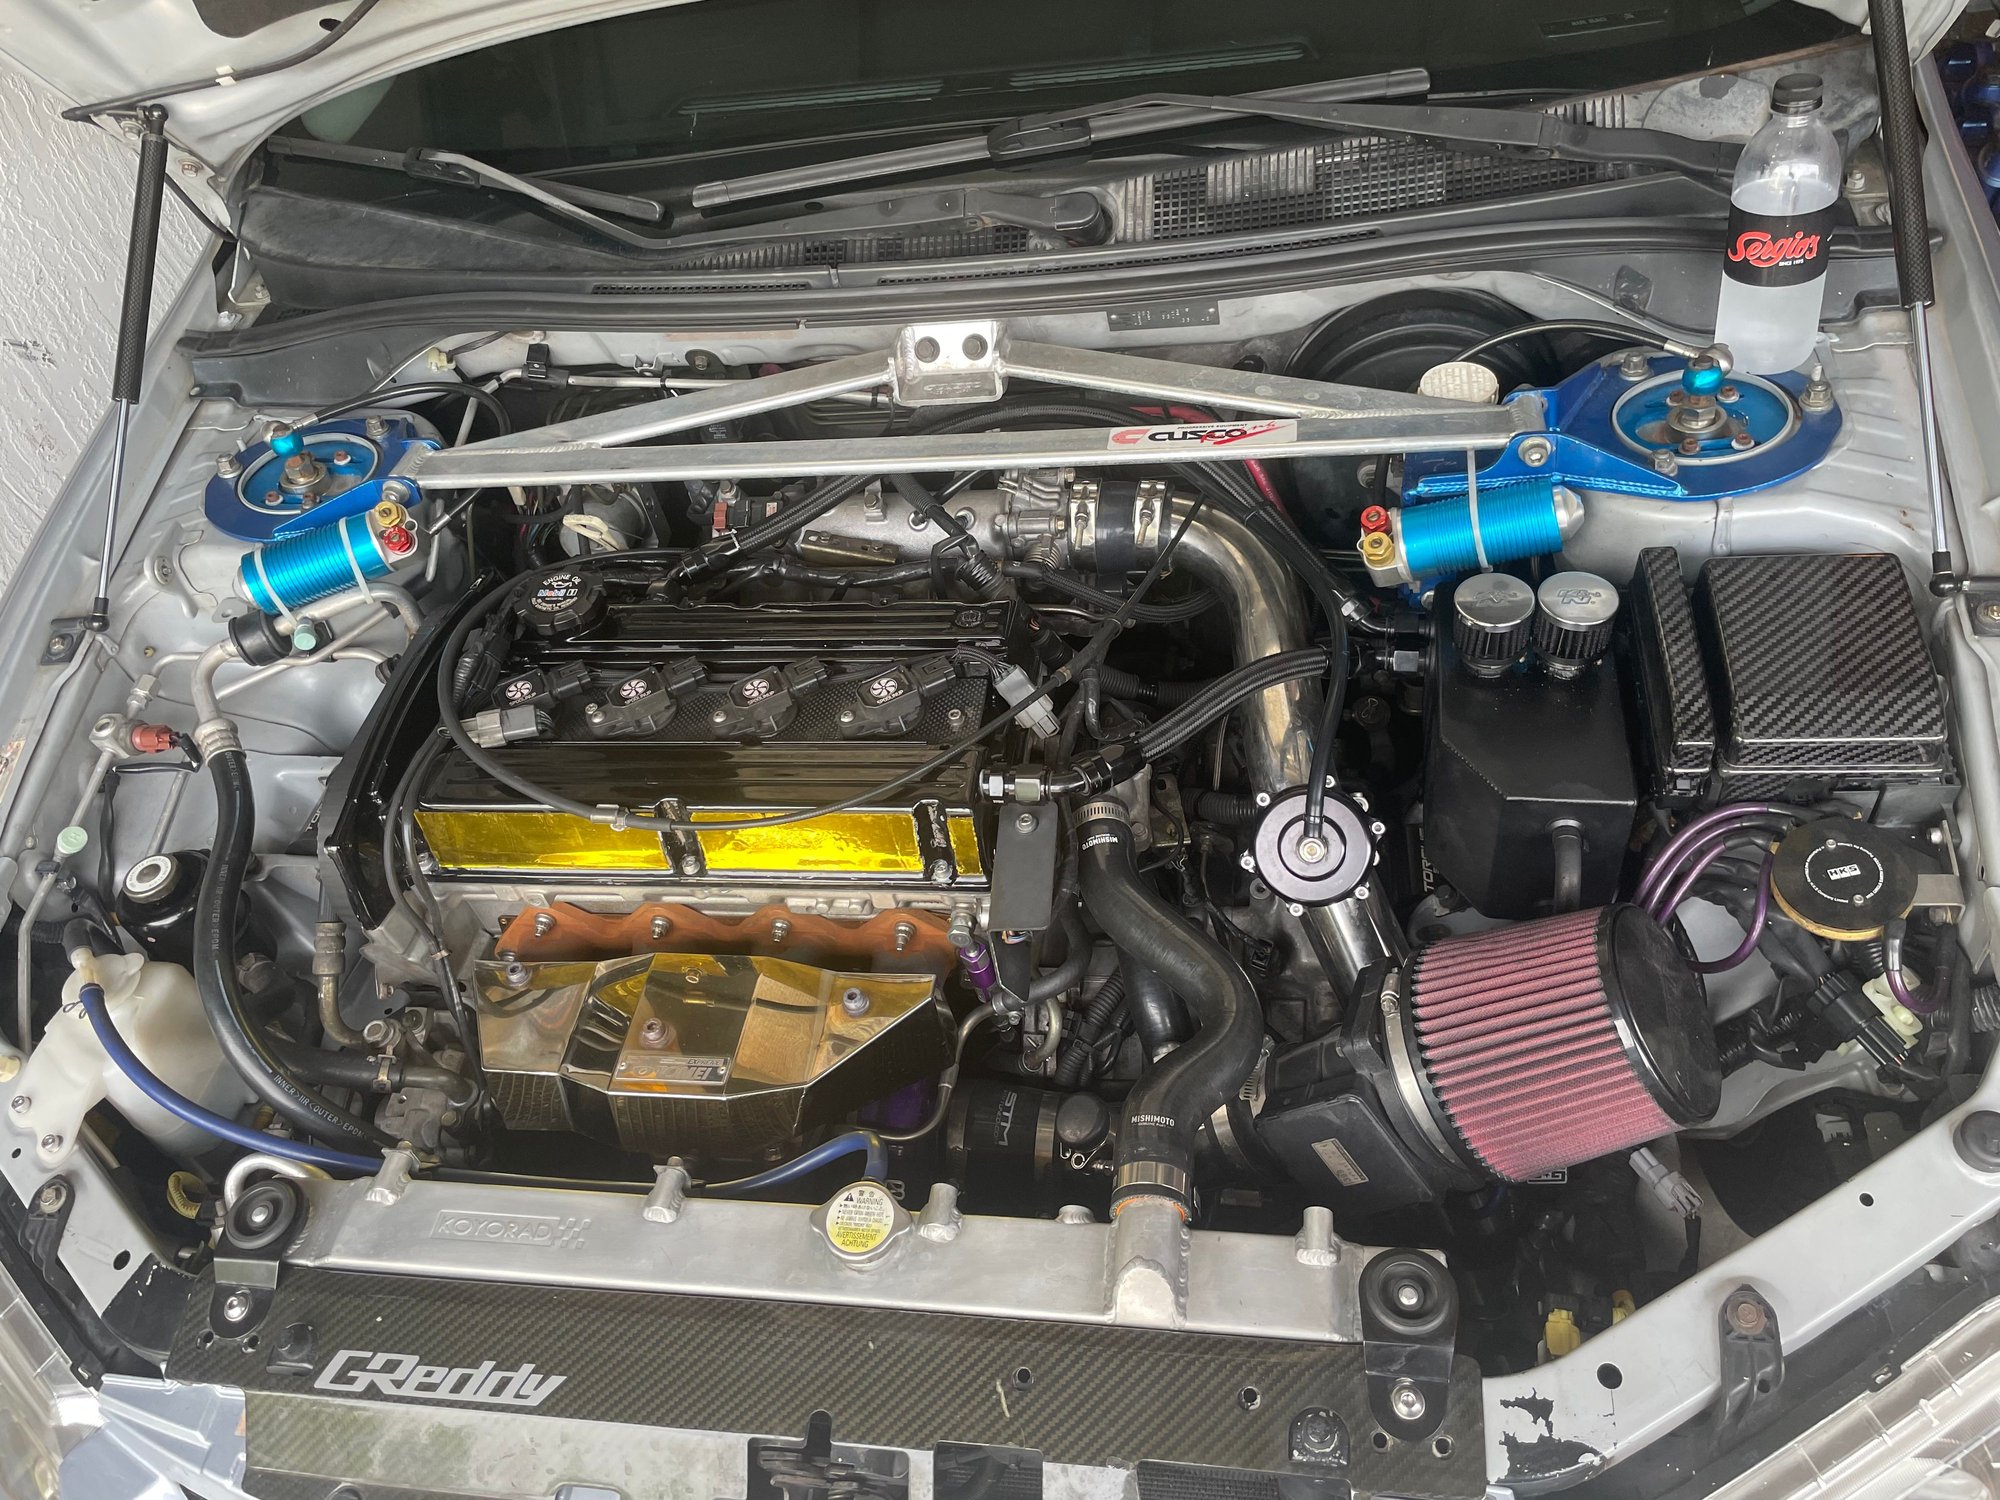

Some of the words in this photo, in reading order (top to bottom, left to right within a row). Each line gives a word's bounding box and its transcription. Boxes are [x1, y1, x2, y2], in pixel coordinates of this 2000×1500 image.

[1728, 231, 1821, 268] Sergio's
[1148, 428, 1247, 442] CUSCO
[542, 574, 571, 586] ENGINE
[537, 588, 567, 597] Mobil
[1828, 864, 1860, 879] HKS
[1131, 1114, 1175, 1127] MISHIMOTO
[856, 1197, 884, 1206] WARNING
[438, 1217, 553, 1241] KOYORAD
[836, 1231, 877, 1241] AVERTISSEMENT
[841, 1239, 869, 1248] ACHTUNG
[314, 1349, 568, 1406] GReddy
